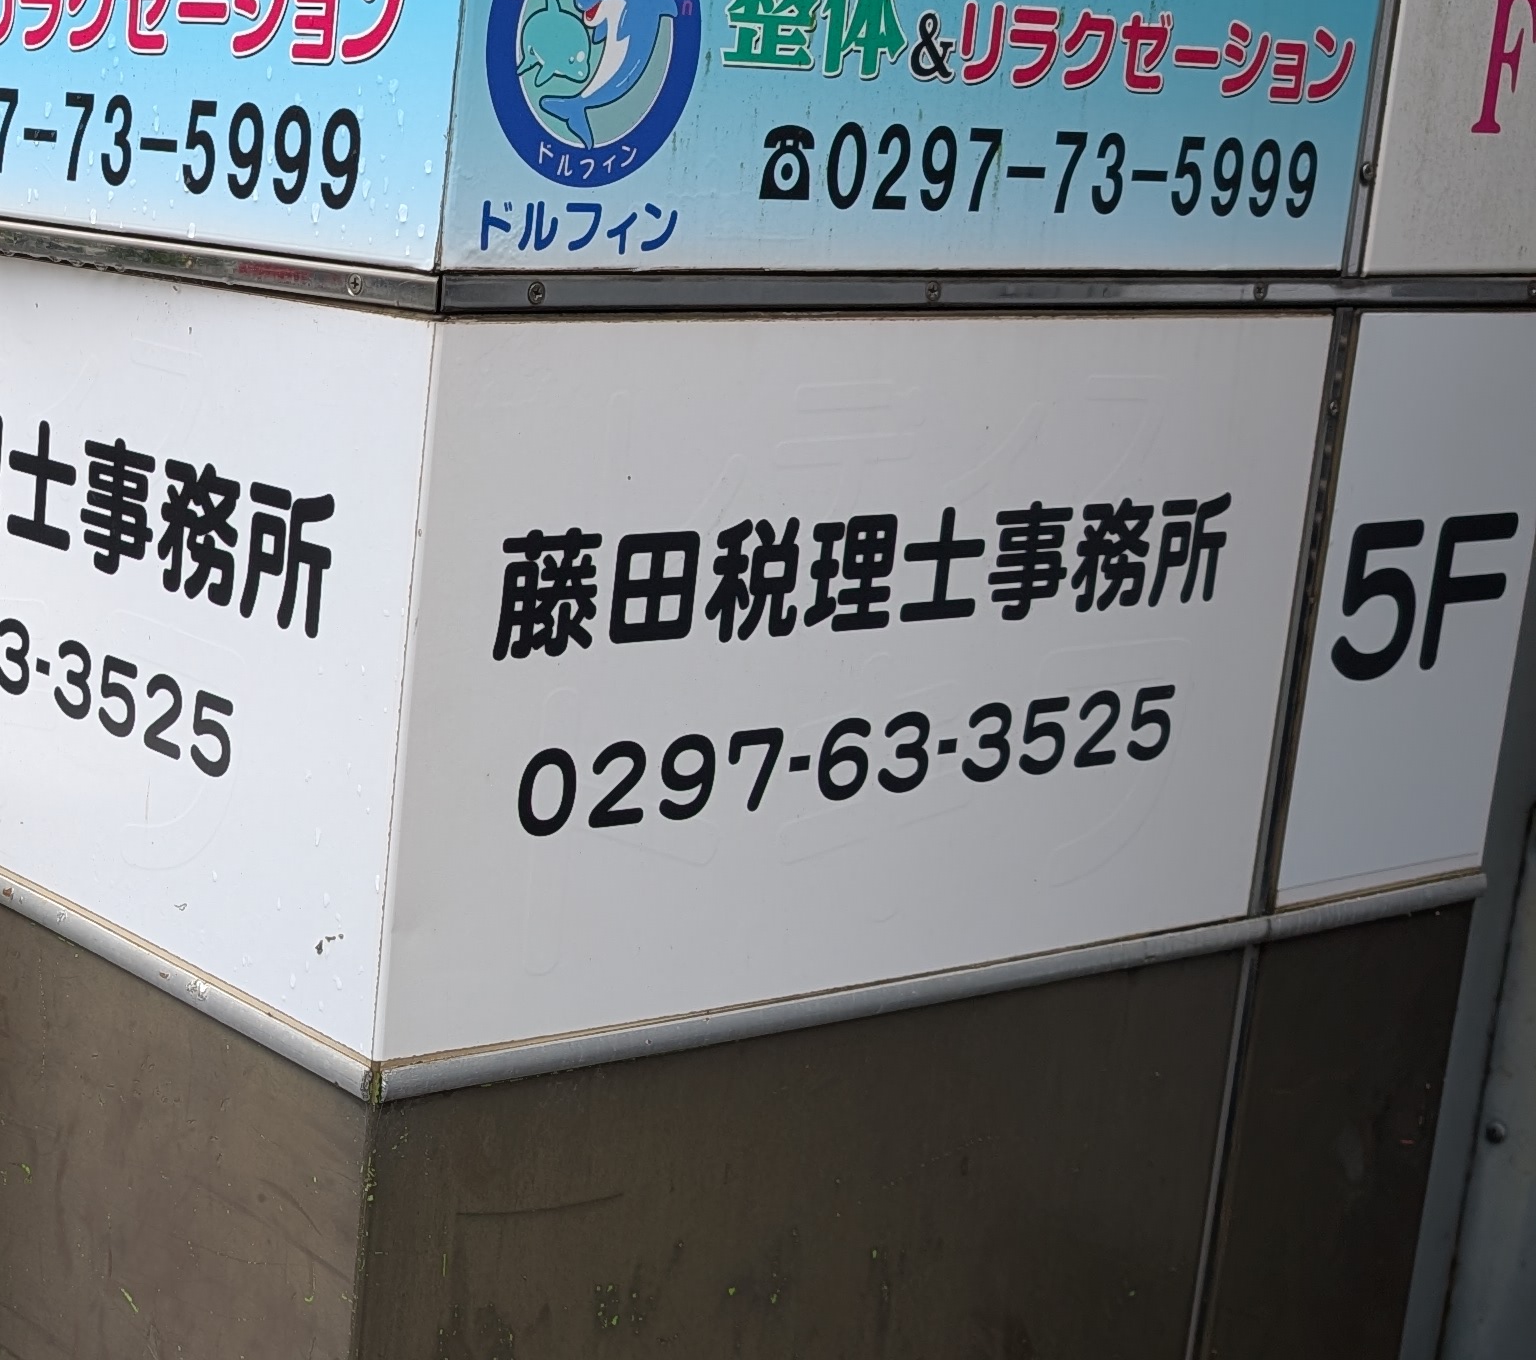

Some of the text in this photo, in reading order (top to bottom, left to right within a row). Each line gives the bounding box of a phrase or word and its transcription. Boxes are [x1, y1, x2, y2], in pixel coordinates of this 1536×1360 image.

[480, 200, 678, 255] ドルフィン
[537, 141, 637, 180] ドルフィン
[492, 492, 1232, 661] 藤田税理士事務所
[1331, 511, 1518, 681] 5F
[516, 684, 1176, 837] 0297-63-3525
